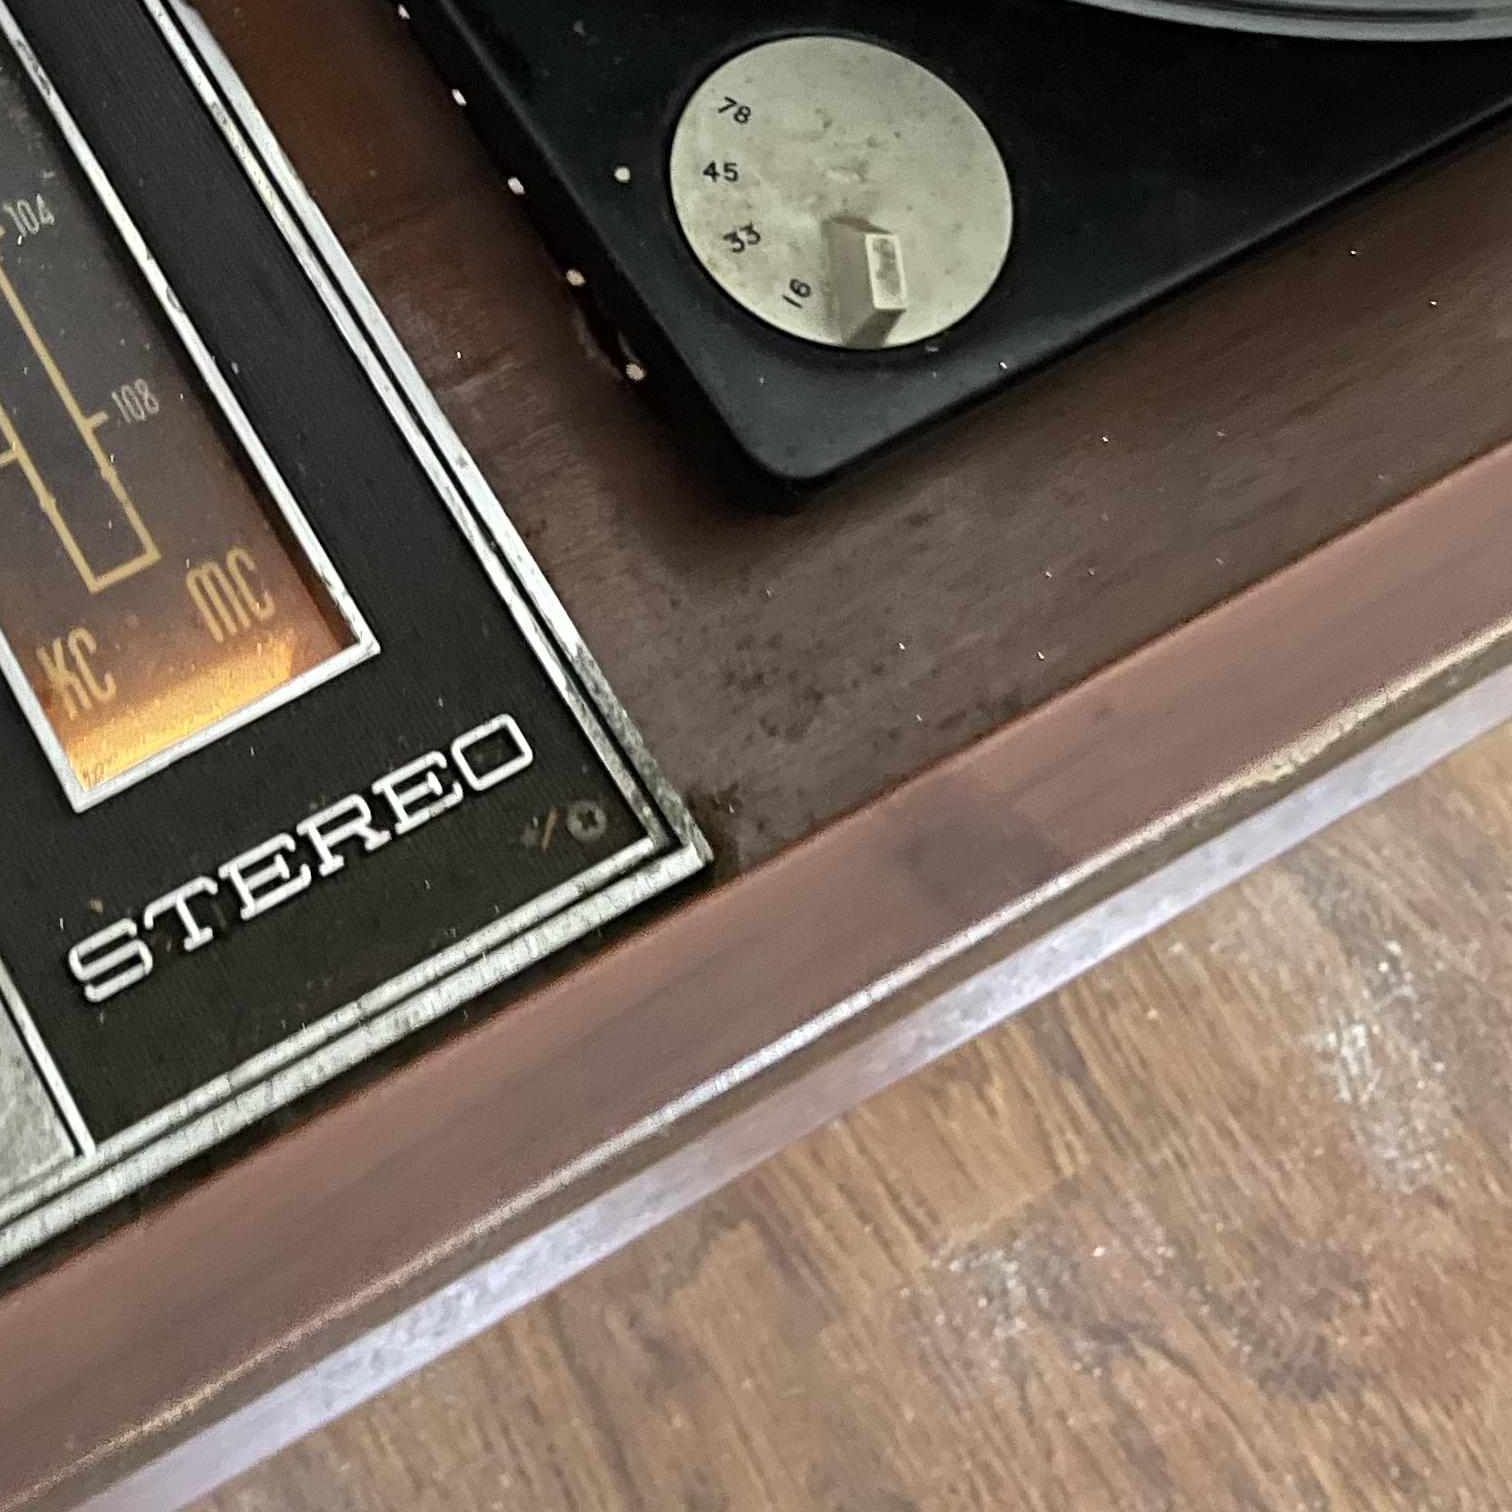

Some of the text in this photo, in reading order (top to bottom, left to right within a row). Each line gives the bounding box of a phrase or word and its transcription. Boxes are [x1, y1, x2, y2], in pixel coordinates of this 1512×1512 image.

[716, 95, 752, 125] 78
[702, 159, 740, 183] 45
[1, 193, 56, 240] 104
[722, 221, 762, 254] 33
[782, 278, 813, 310] 16
[111, 377, 161, 426] 108
[36, 546, 276, 721] KC MC
[67, 711, 535, 1004] STEREO
